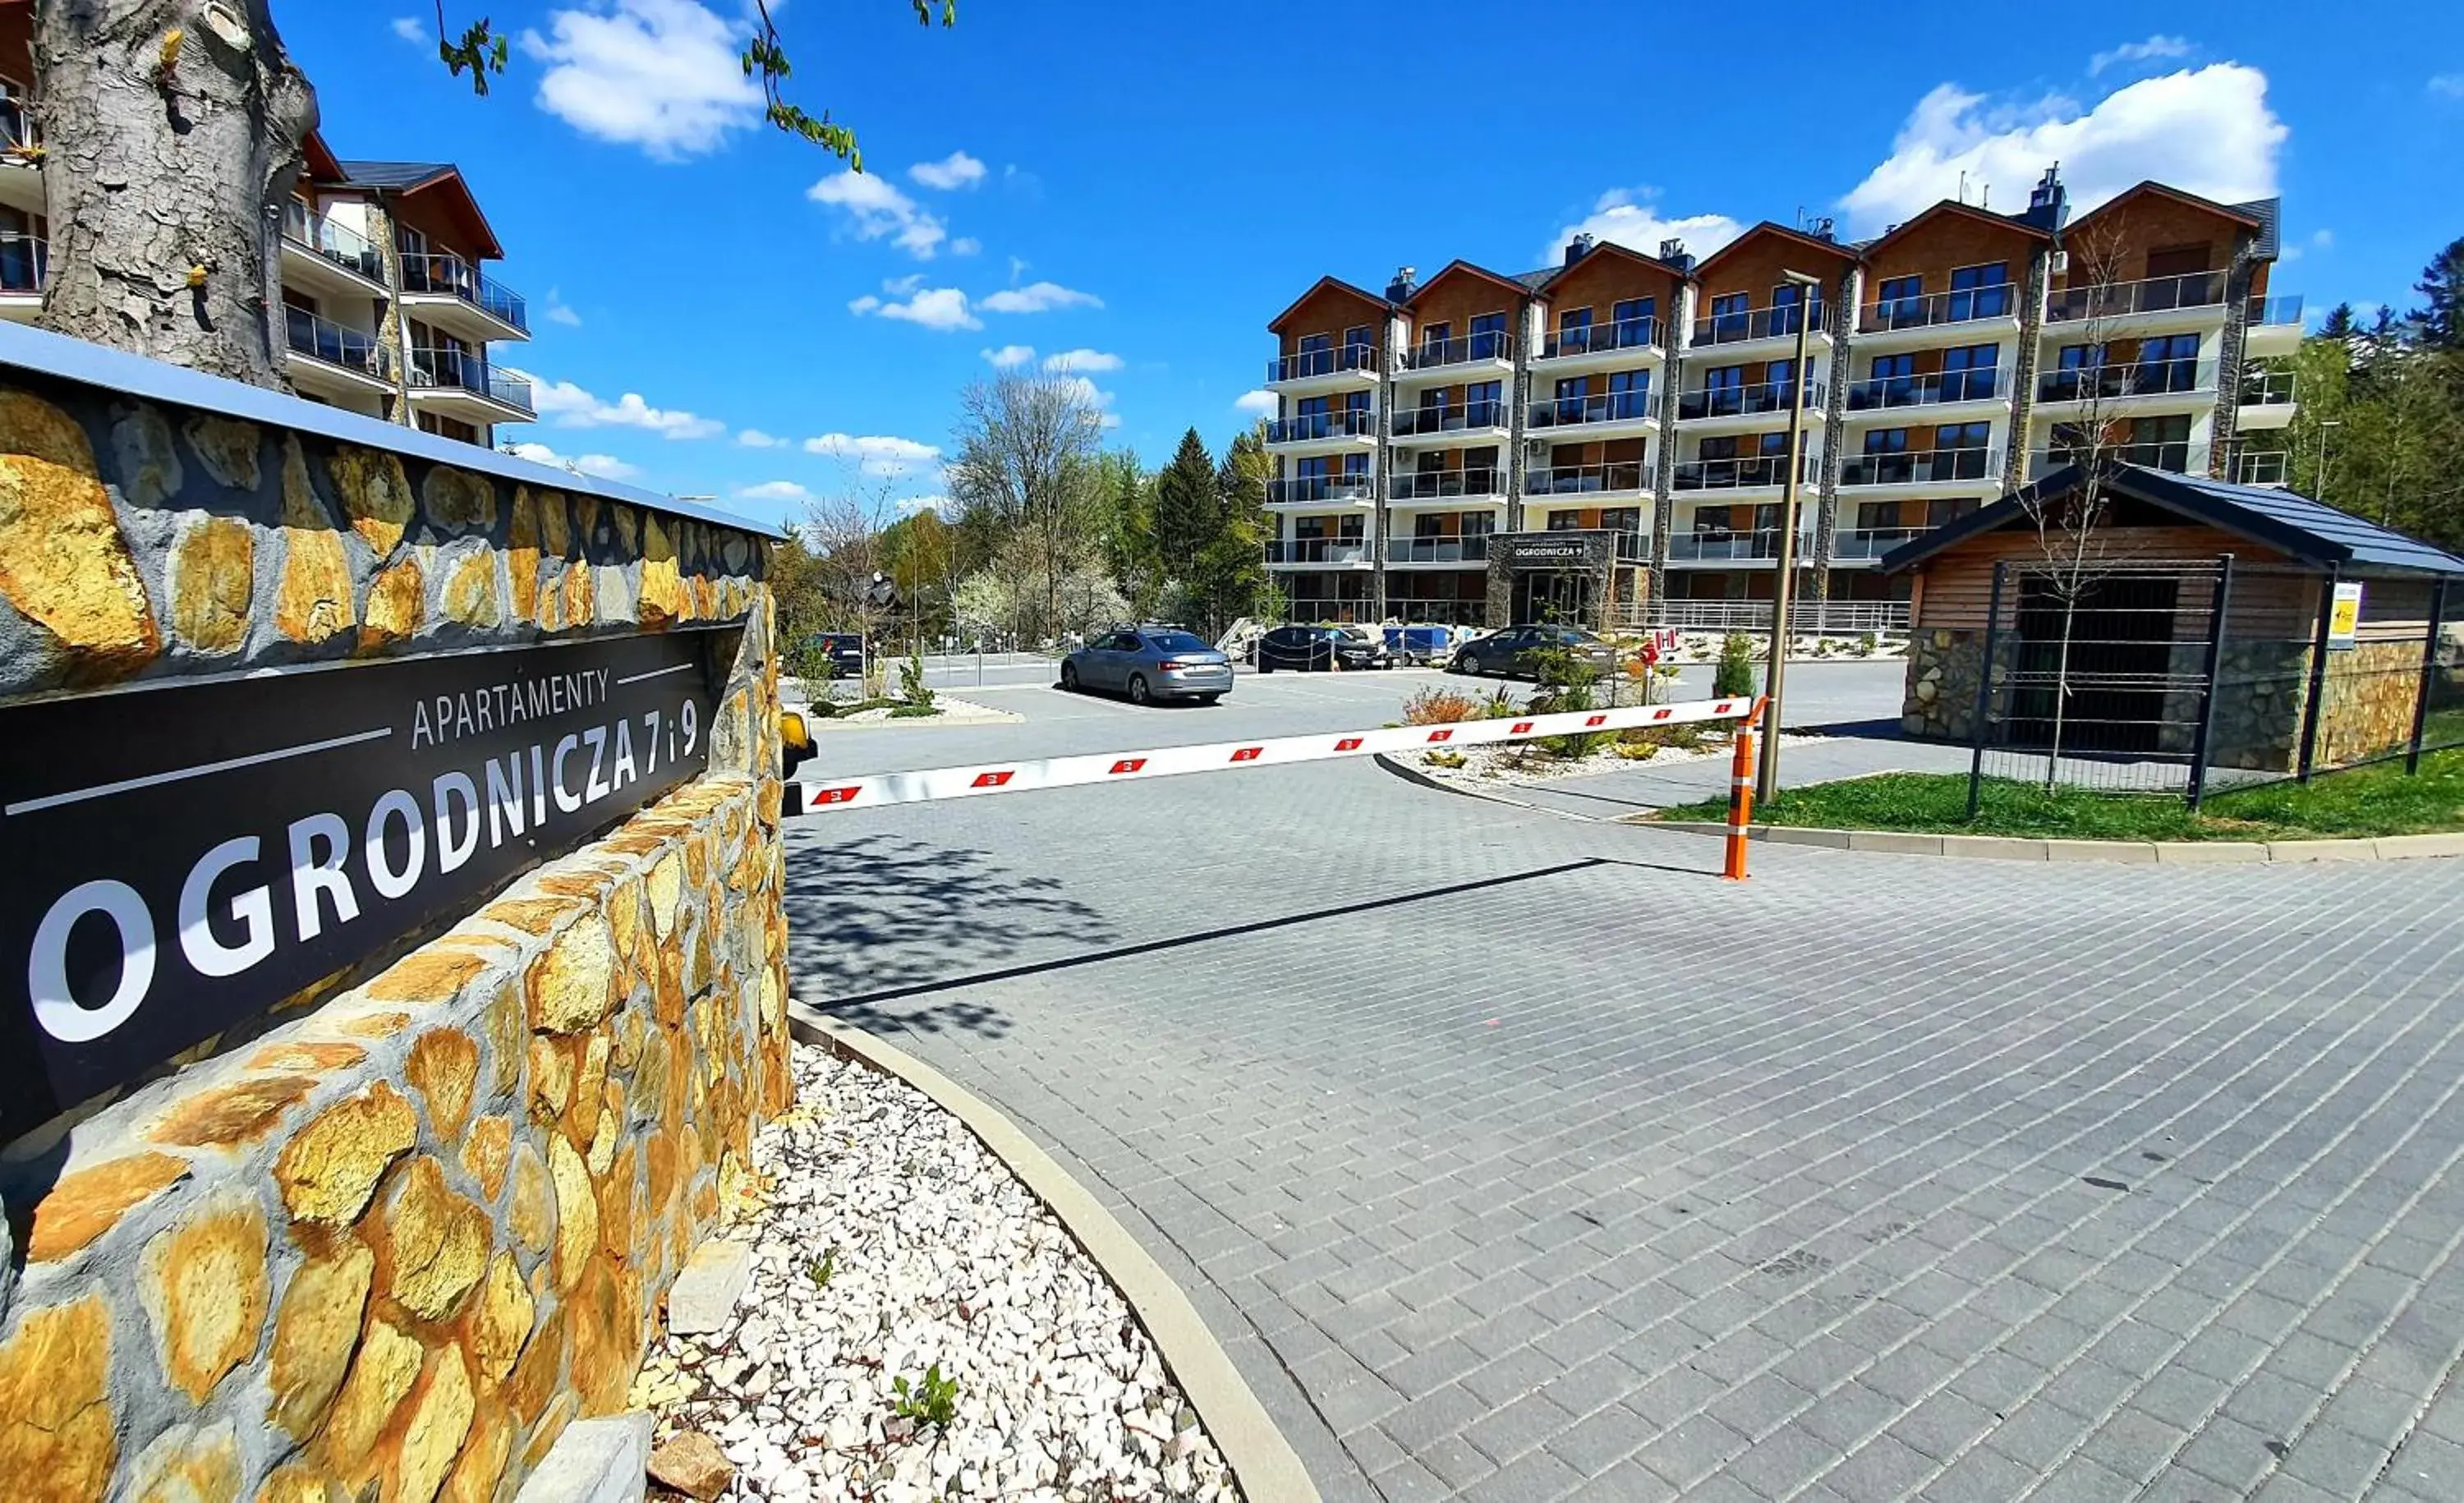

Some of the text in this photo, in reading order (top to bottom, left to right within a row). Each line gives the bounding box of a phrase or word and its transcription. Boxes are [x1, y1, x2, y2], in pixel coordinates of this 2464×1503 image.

[1575, 547, 1583, 556] 9
[411, 667, 609, 750] APARTAMENTY
[28, 699, 697, 1043] OGRODNICZA 7 i 9
